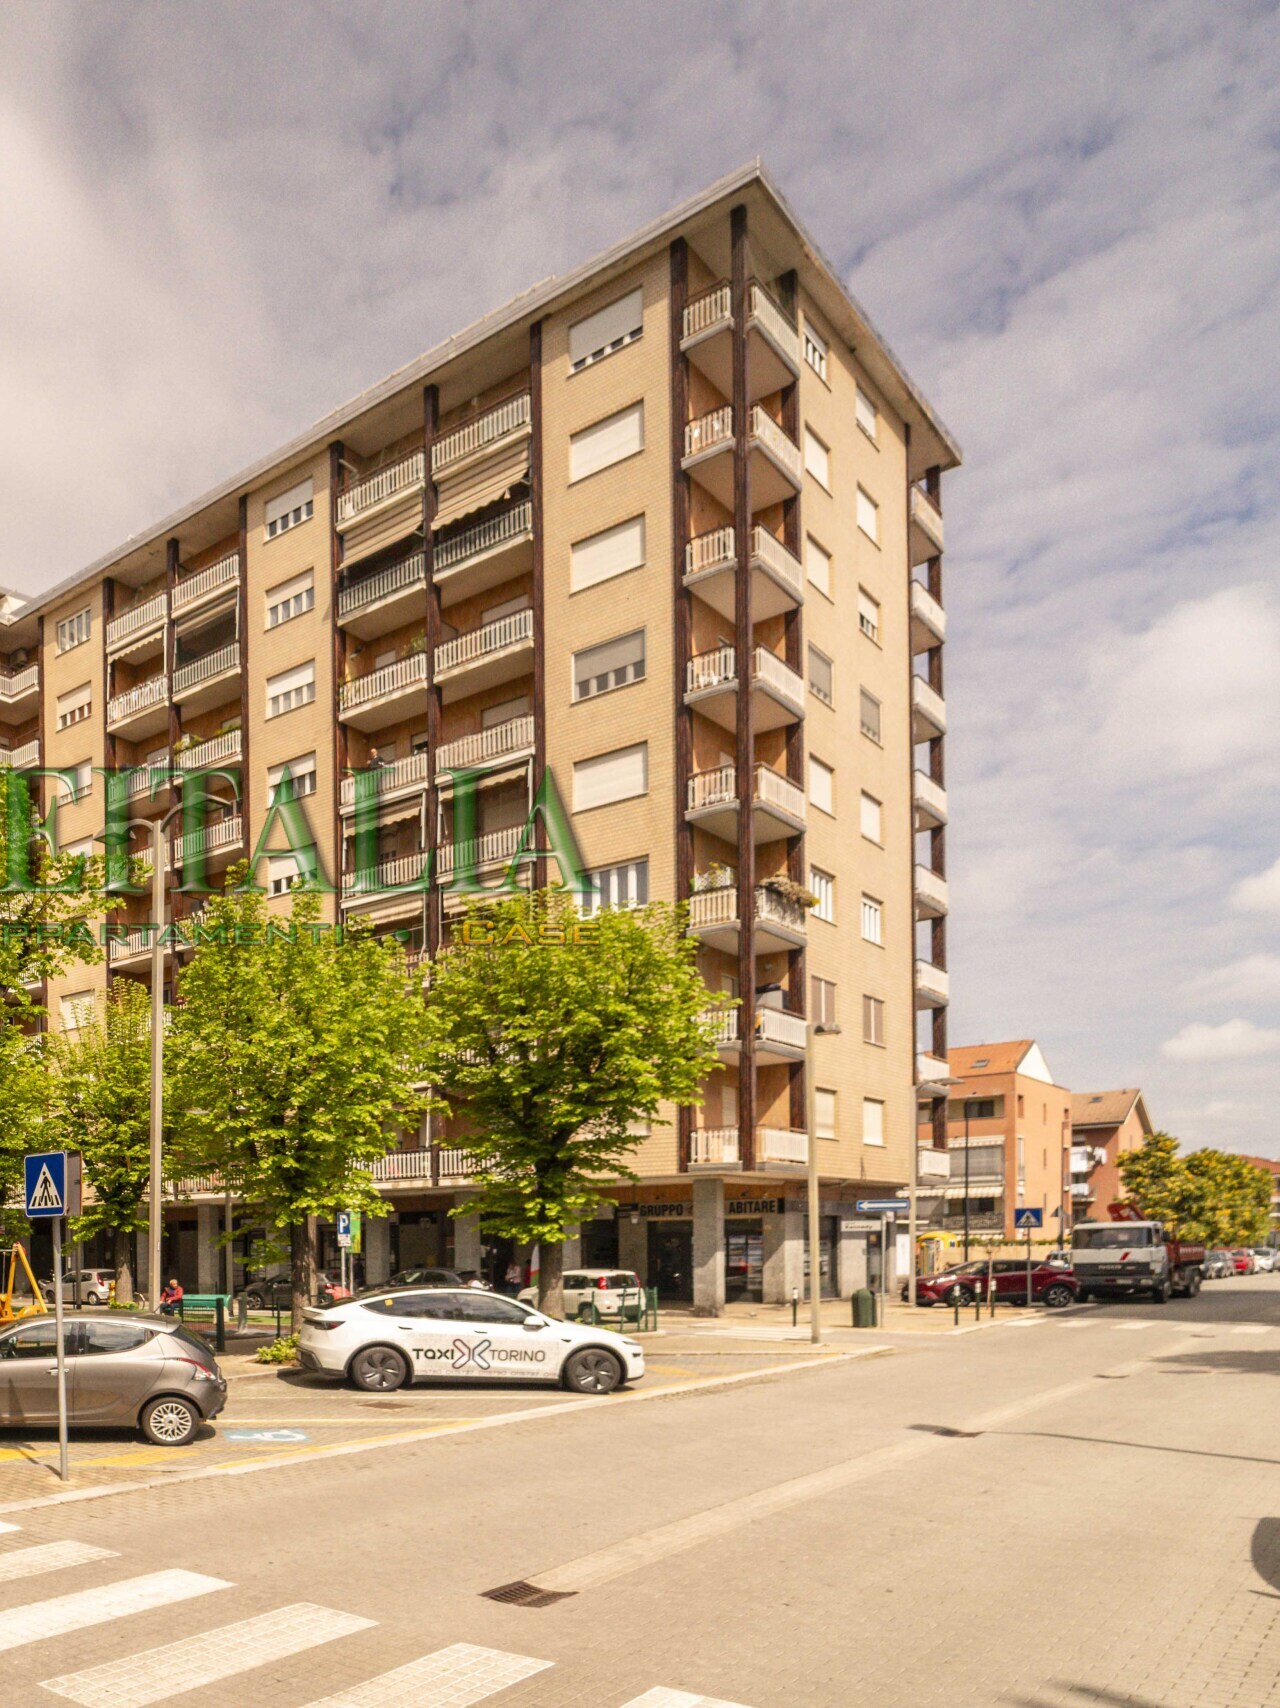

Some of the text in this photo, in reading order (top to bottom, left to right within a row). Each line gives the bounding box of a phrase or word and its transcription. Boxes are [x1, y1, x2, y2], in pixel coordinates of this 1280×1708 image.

[640, 1200, 776, 1217] GRUPPO ABITARE
[339, 1214, 349, 1233] P
[489, 1349, 546, 1363] TORINO
